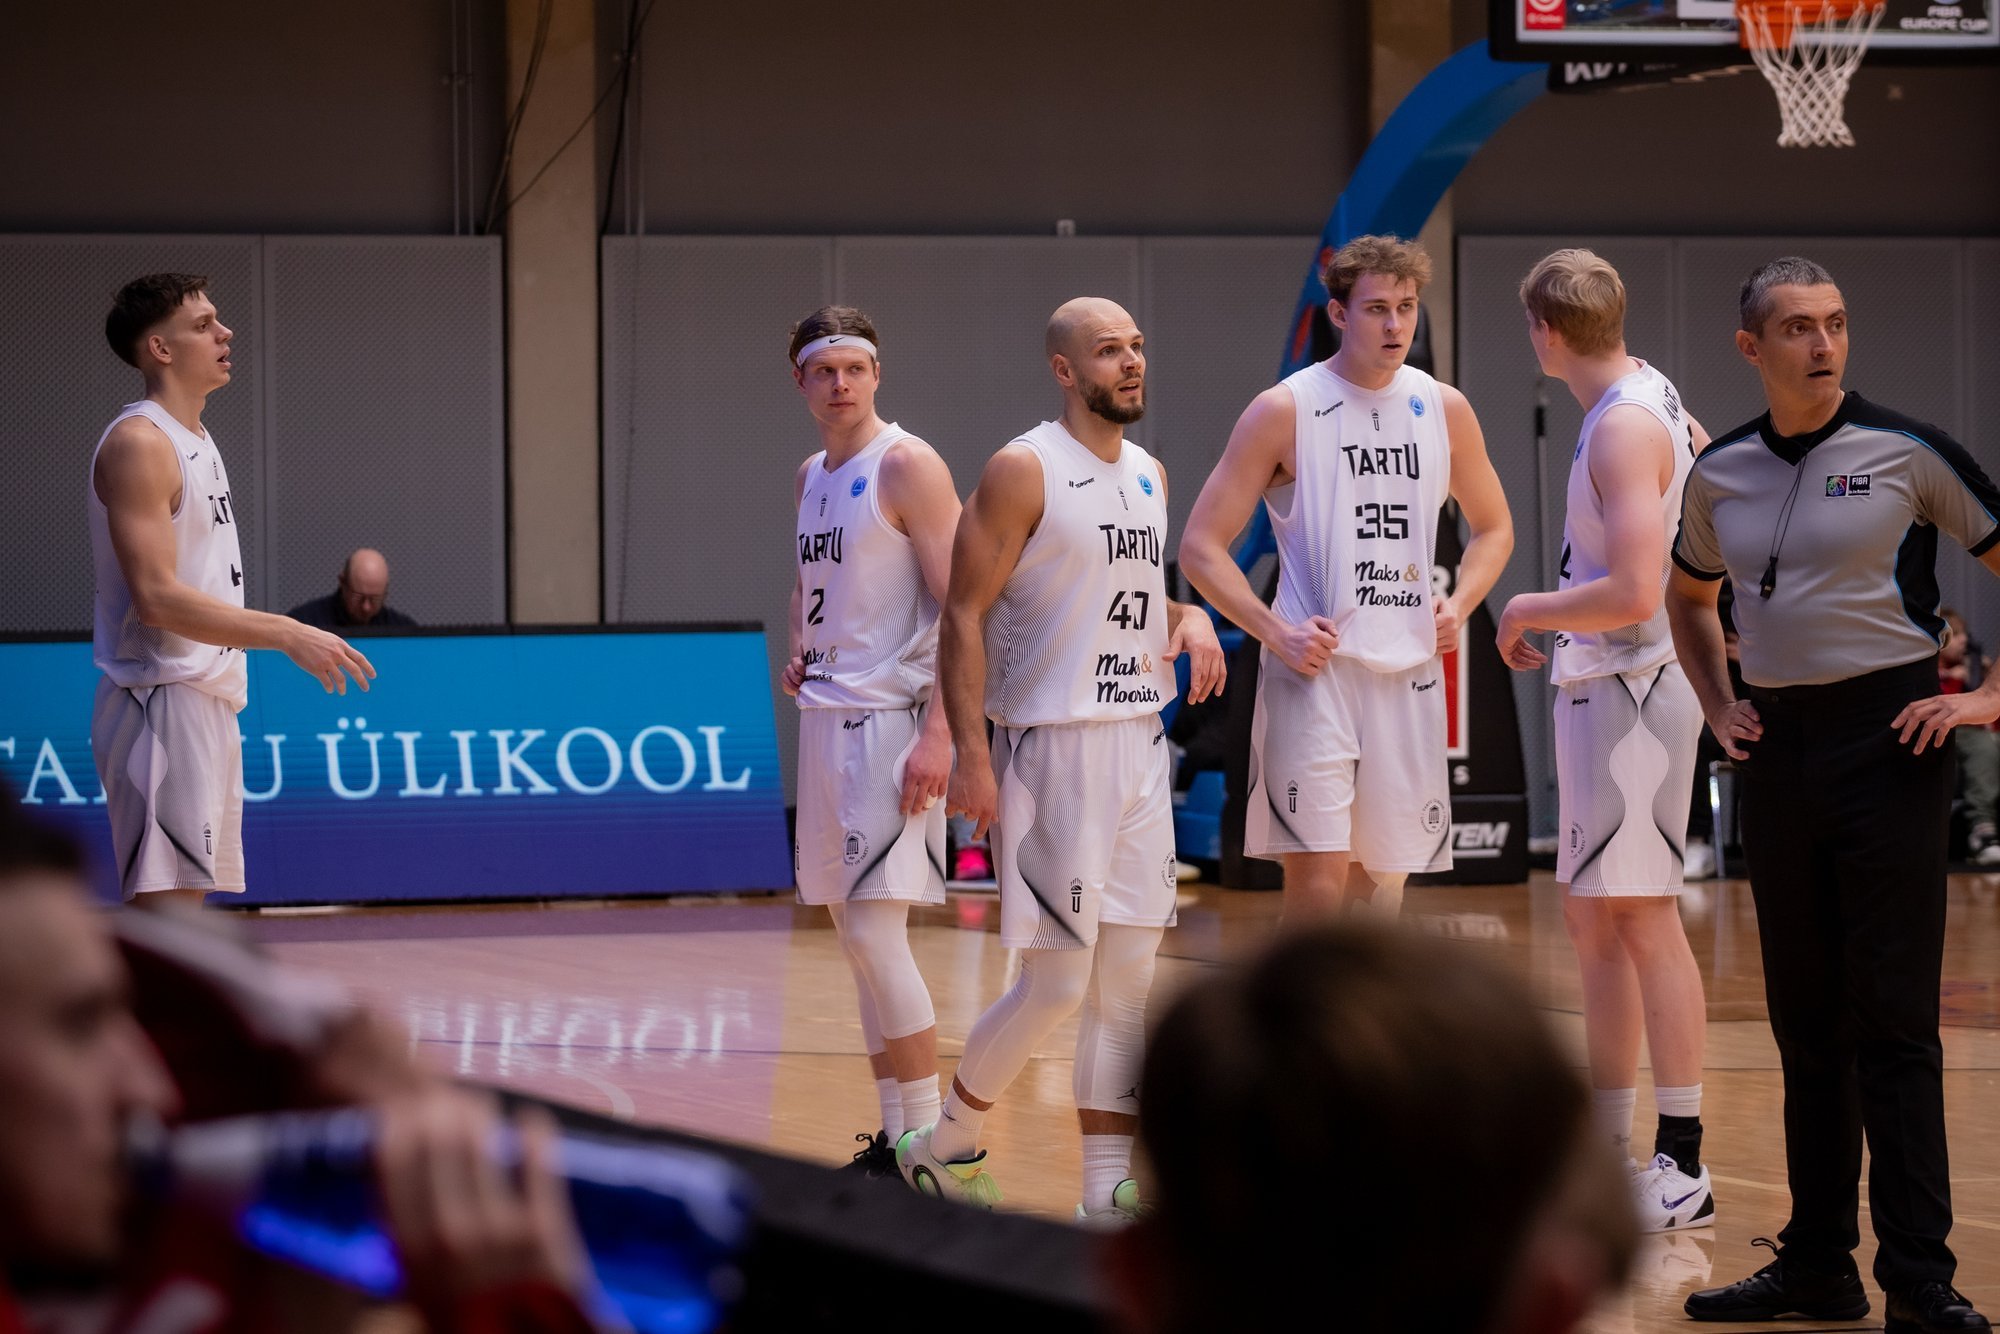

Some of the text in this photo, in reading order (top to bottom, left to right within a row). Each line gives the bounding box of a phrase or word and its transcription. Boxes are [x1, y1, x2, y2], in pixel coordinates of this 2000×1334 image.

[1900, 17, 1988, 31] EUROPE CUP
[1341, 442, 1420, 481] TARTU
[1851, 476, 1868, 486] FIBA
[1355, 503, 1409, 540] 35
[799, 526, 844, 565] TARTU
[1098, 524, 1160, 568] TARTU
[1355, 560, 1420, 582] Maks &
[807, 588, 825, 626] 2
[1106, 590, 1150, 630] 47
[1355, 585, 1422, 608] Moorits
[803, 646, 838, 666] aks &
[1095, 653, 1141, 676] Maks
[1096, 681, 1160, 703] Moorits
[317, 717, 752, 801] ÜLIKOOL
